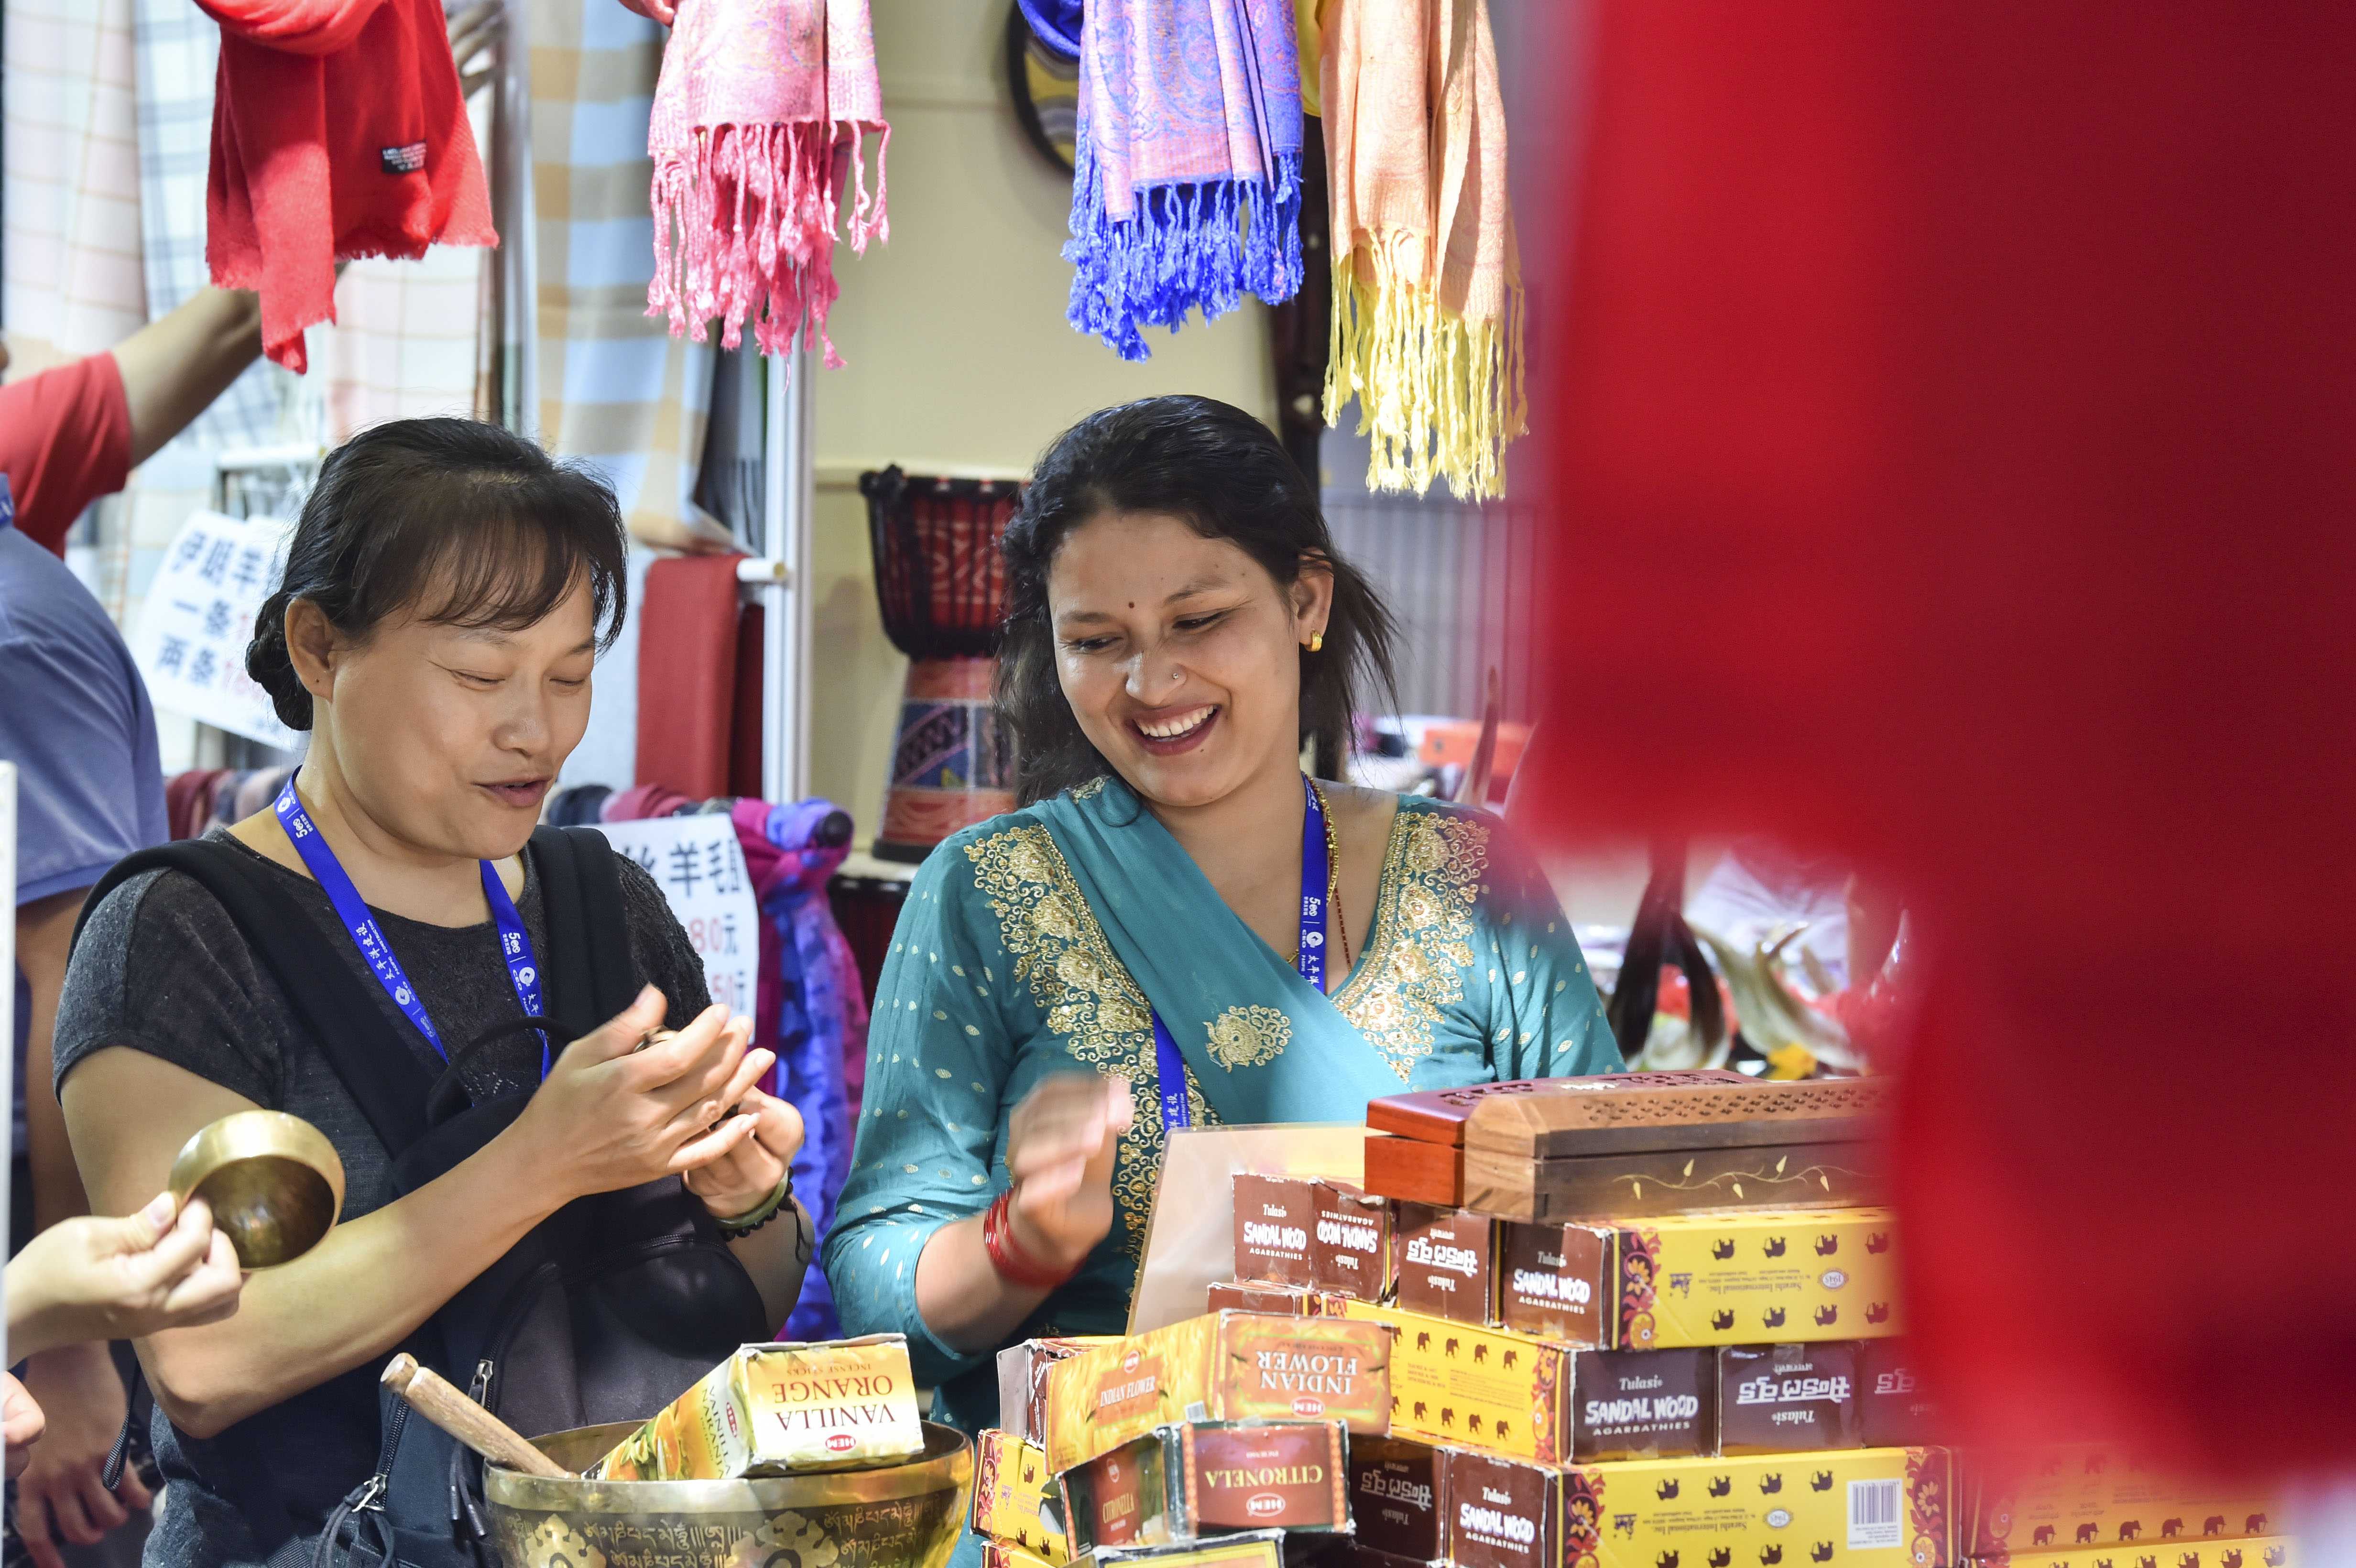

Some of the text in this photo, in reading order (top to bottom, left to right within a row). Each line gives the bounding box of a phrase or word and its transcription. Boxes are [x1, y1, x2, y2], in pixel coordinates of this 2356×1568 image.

[367, 919, 388, 954] CONSTRUCTION
[508, 932, 521, 953] 500
[513, 969, 523, 991] CEO
[1263, 1204, 1285, 1219] Tulasi
[1321, 1210, 1374, 1226] AGARBATHIES
[1243, 1221, 1308, 1252] SANDAL WOOD
[1316, 1219, 1378, 1253] SANDAL WOOD
[1249, 1248, 1304, 1261] AGARBATHIES
[1513, 1268, 1591, 1305] SANDAL WOOD
[1723, 1284, 1773, 1294] International
[1518, 1296, 1585, 1315] AGARBATHIES
[1255, 1350, 1358, 1376] FLOWER
[772, 1375, 893, 1404] ORANGE
[1100, 1375, 1156, 1408] INDIAN FLOWER
[1259, 1370, 1352, 1395] INDIAN
[1619, 1374, 1659, 1391] Tulasi
[774, 1403, 896, 1431] VANILLA
[1293, 1402, 1324, 1415] HEM
[1583, 1394, 1699, 1425] SANDAL WOOD
[1776, 1410, 1815, 1426] Tulasi
[1592, 1421, 1690, 1436] AGARBATHIES
[826, 1438, 855, 1449] HEM
[1205, 1464, 1323, 1488] CITRONELA
[1460, 1502, 1536, 1545] SANDAL WOOD
[1668, 1523, 1718, 1534] International
[1465, 1531, 1529, 1554] AGARBATHIES
